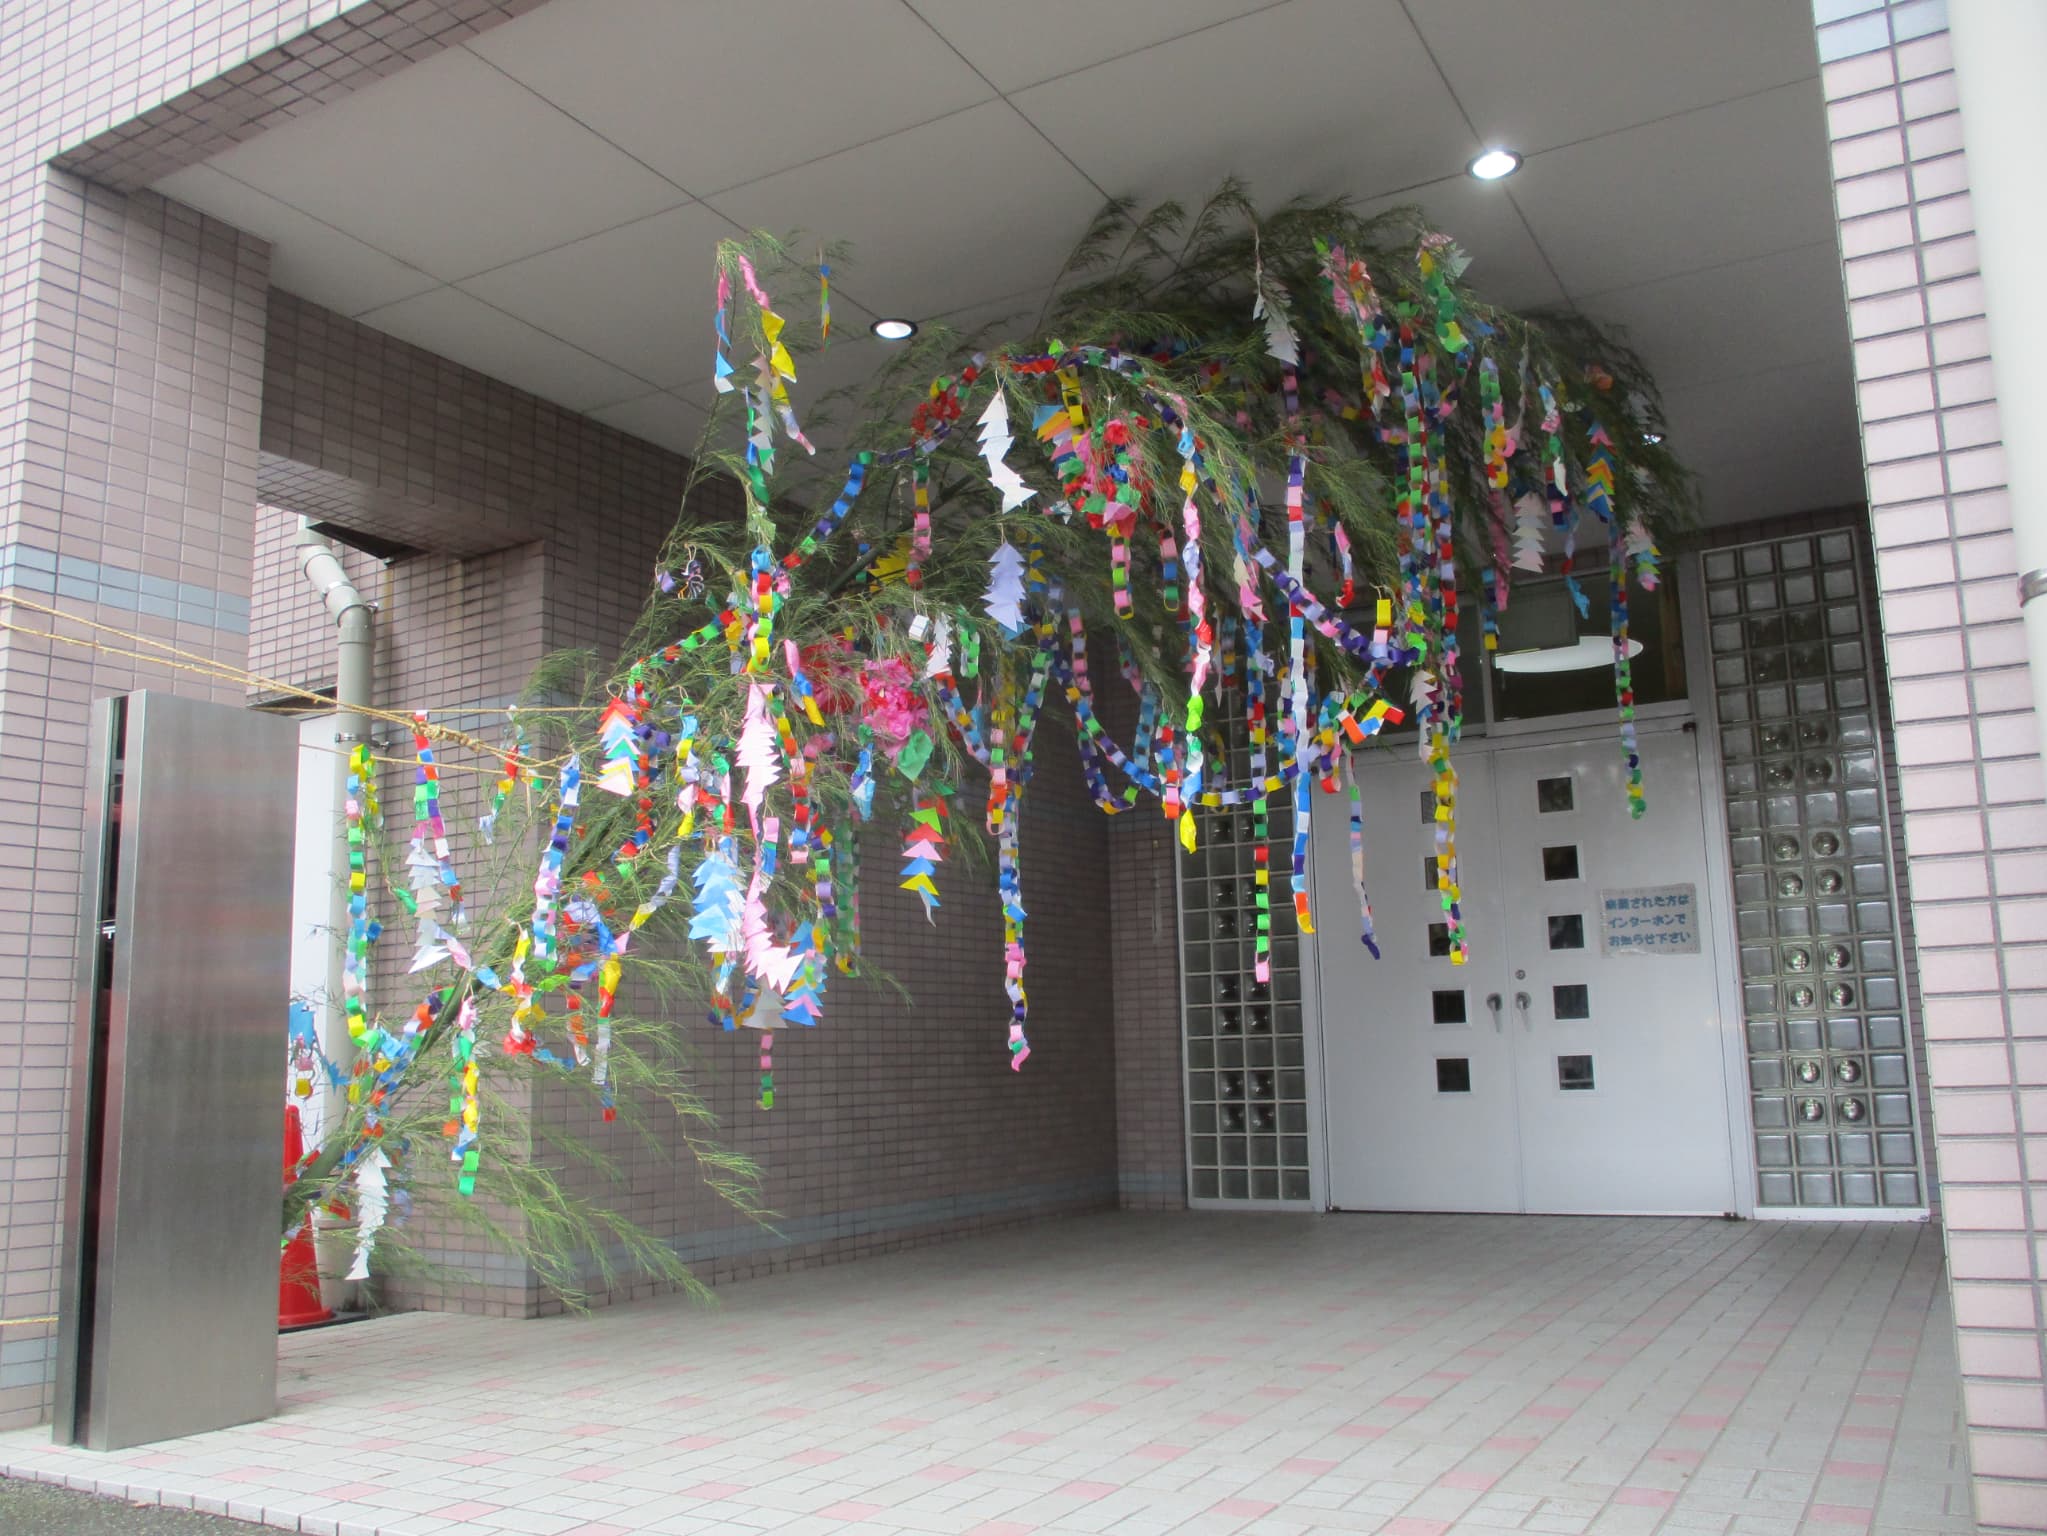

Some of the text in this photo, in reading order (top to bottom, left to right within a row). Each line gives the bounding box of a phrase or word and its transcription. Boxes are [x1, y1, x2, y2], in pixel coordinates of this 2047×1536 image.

[1608, 913, 1686, 928] インターホンで
[1608, 931, 1690, 947] お知らせ下さい
